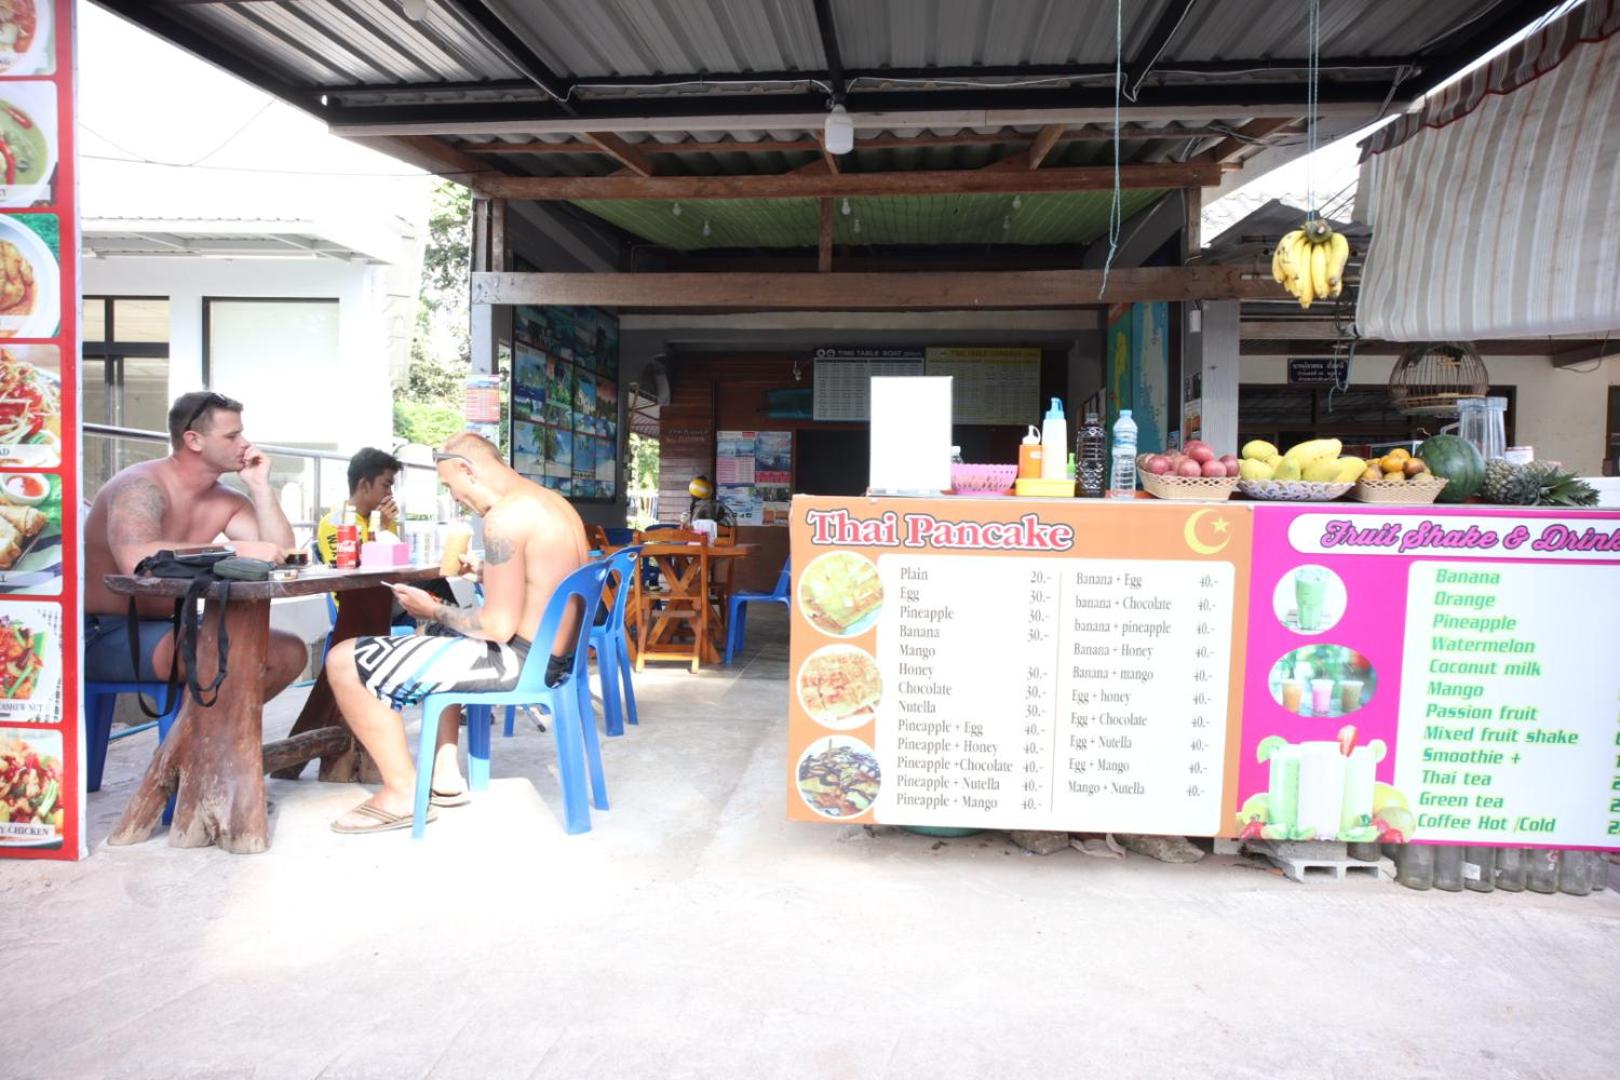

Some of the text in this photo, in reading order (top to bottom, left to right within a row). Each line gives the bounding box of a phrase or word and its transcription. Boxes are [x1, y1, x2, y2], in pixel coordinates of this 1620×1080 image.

[806, 508, 1074, 551] Thai Pancake
[1320, 519, 1402, 548] Fruit
[1399, 519, 1499, 553] Shake
[1503, 525, 1530, 550] &
[901, 567, 928, 580] Plain
[1077, 572, 1112, 585] Banana
[1125, 573, 1142, 589] Egg
[1436, 569, 1500, 584] Banana
[901, 587, 919, 601] Egg
[1435, 591, 1495, 610] Orange
[1076, 595, 1111, 608] banana
[1123, 597, 1171, 610] Chocolate
[900, 606, 953, 622] Pineapple
[900, 625, 939, 637] Banana
[1075, 619, 1110, 632] banana
[1122, 621, 1171, 638] pineapple
[1433, 614, 1517, 632] Pineapple
[900, 644, 935, 658] Mango
[1074, 643, 1109, 656] Banana
[1122, 644, 1153, 660] Honey
[1432, 637, 1535, 653] Watermelon
[899, 663, 932, 675] Honey
[1073, 666, 1108, 679] Banana
[1121, 670, 1153, 683] mango
[1430, 659, 1540, 676] Coconut milk
[899, 682, 951, 695] Chocolate
[1428, 681, 1484, 699] Mango
[1072, 689, 1089, 703] Egg
[1101, 689, 1129, 705] honey
[899, 701, 936, 713] Nutella
[1426, 704, 1537, 720] Passion fruit
[899, 719, 950, 733] Pineapple
[965, 721, 983, 736] Egg
[1071, 712, 1088, 727] Egg
[1099, 713, 1147, 726] Chocolate
[1070, 735, 1087, 751] Egg
[1099, 736, 1131, 748] Nutella
[1426, 726, 1579, 744] Mixed fruit shake
[898, 738, 951, 752] Pineapple
[964, 740, 997, 755] Honey
[898, 756, 950, 770] Pineapple
[1423, 748, 1504, 764] Smoothie
[1069, 758, 1086, 773] Egg
[1097, 759, 1129, 774] Mango
[897, 775, 949, 789] Pineapple
[963, 777, 999, 790] Nutella
[1423, 770, 1491, 785] Thai tea
[1069, 780, 1100, 796] Mango
[1112, 782, 1144, 794] Nutella
[897, 793, 949, 807] Pineapple
[963, 796, 997, 812] Mango
[1418, 791, 1504, 808] Green tea
[1417, 813, 1472, 829] Coffee
[1478, 816, 1507, 830] Hot
[8, 827, 49, 835] CHICKEN
